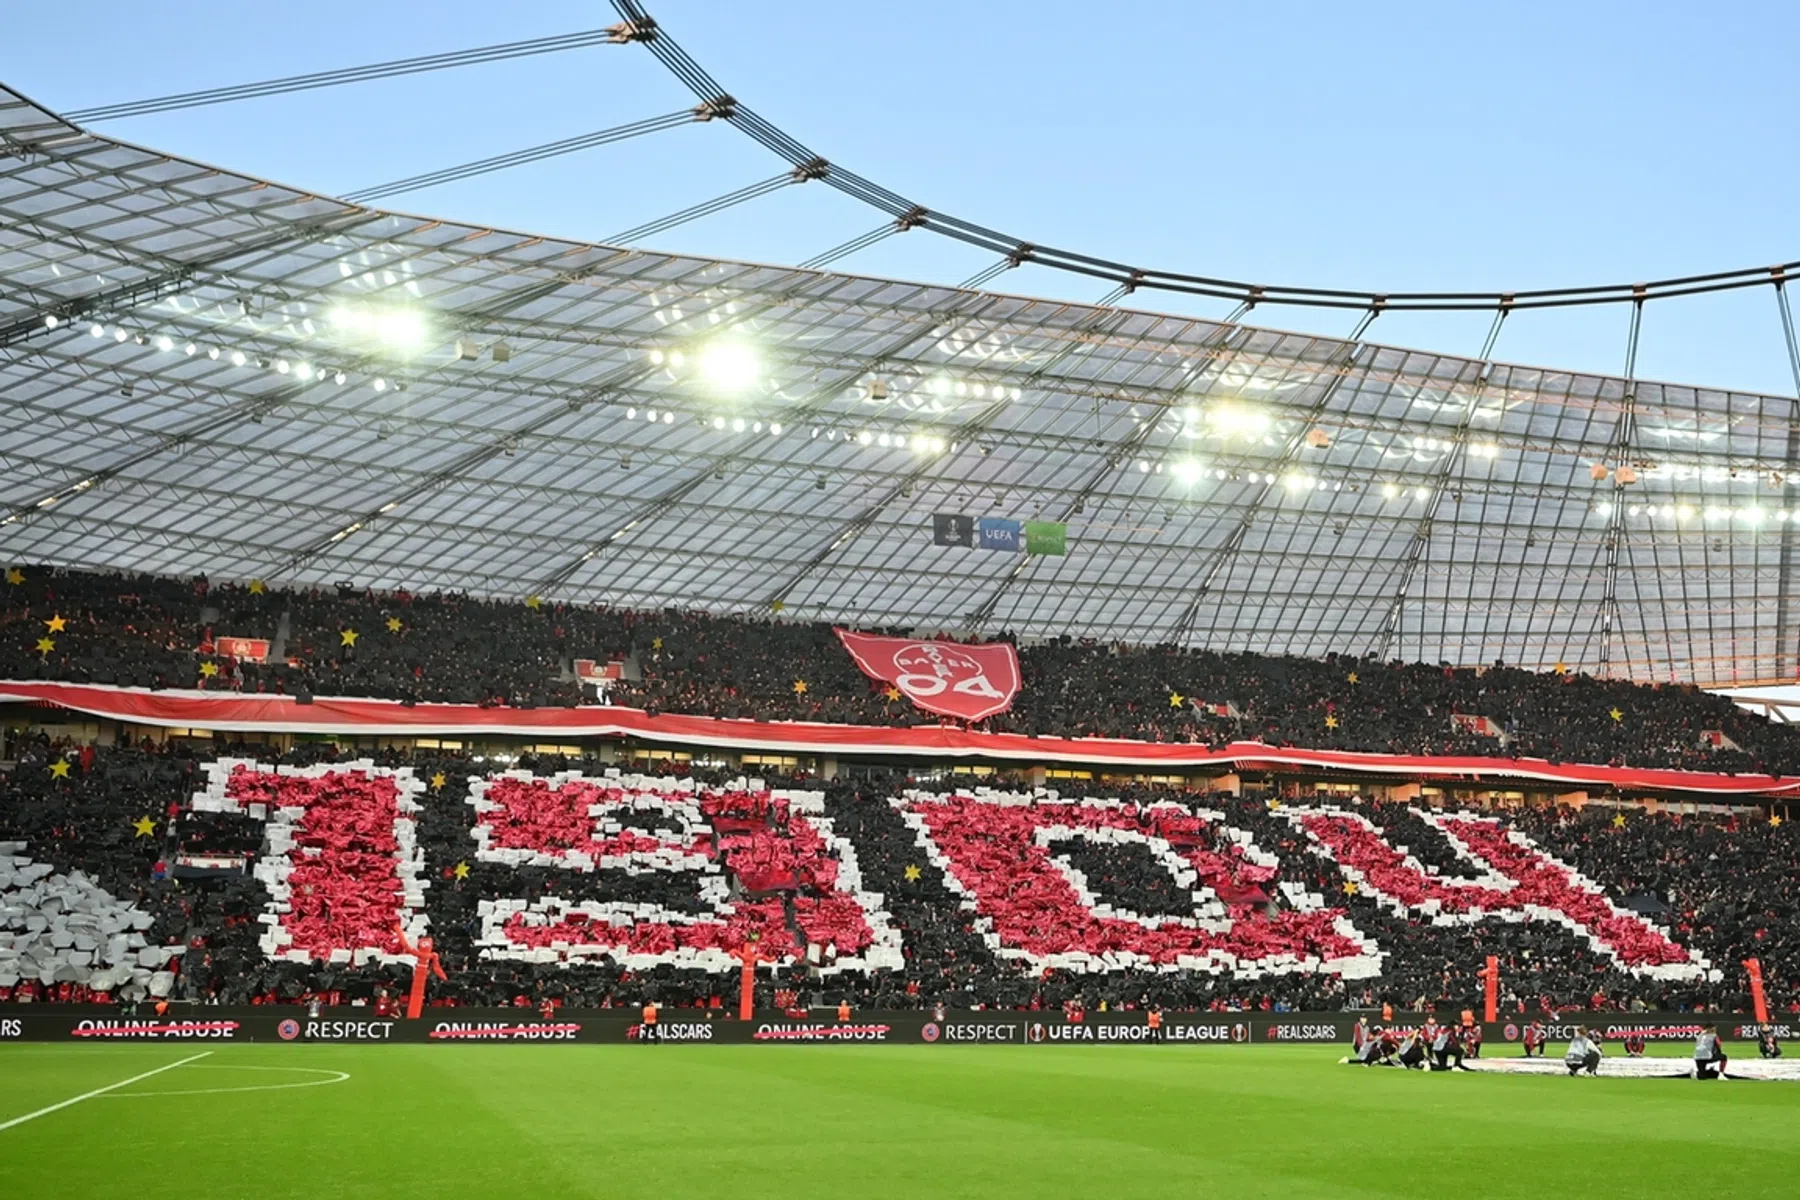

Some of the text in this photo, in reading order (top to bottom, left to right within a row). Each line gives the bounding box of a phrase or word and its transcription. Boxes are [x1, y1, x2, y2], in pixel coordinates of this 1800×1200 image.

[985, 529, 1013, 541] UEFA
[895, 674, 1006, 699] 04
[78, 1020, 234, 1038] ONLINE ABUSE
[308, 1022, 394, 1038] RESPECT
[435, 1023, 576, 1039] ONLINE ABUSE
[758, 1024, 886, 1040] ONLINE ABUSE
[946, 1025, 1016, 1040] RESPECT
[1049, 1025, 1093, 1040] UEFA
[1166, 1025, 1228, 1040] LEAGUE
[1267, 1024, 1336, 1039] #REALSCARS
[1607, 1025, 1656, 1039] ONLINE
